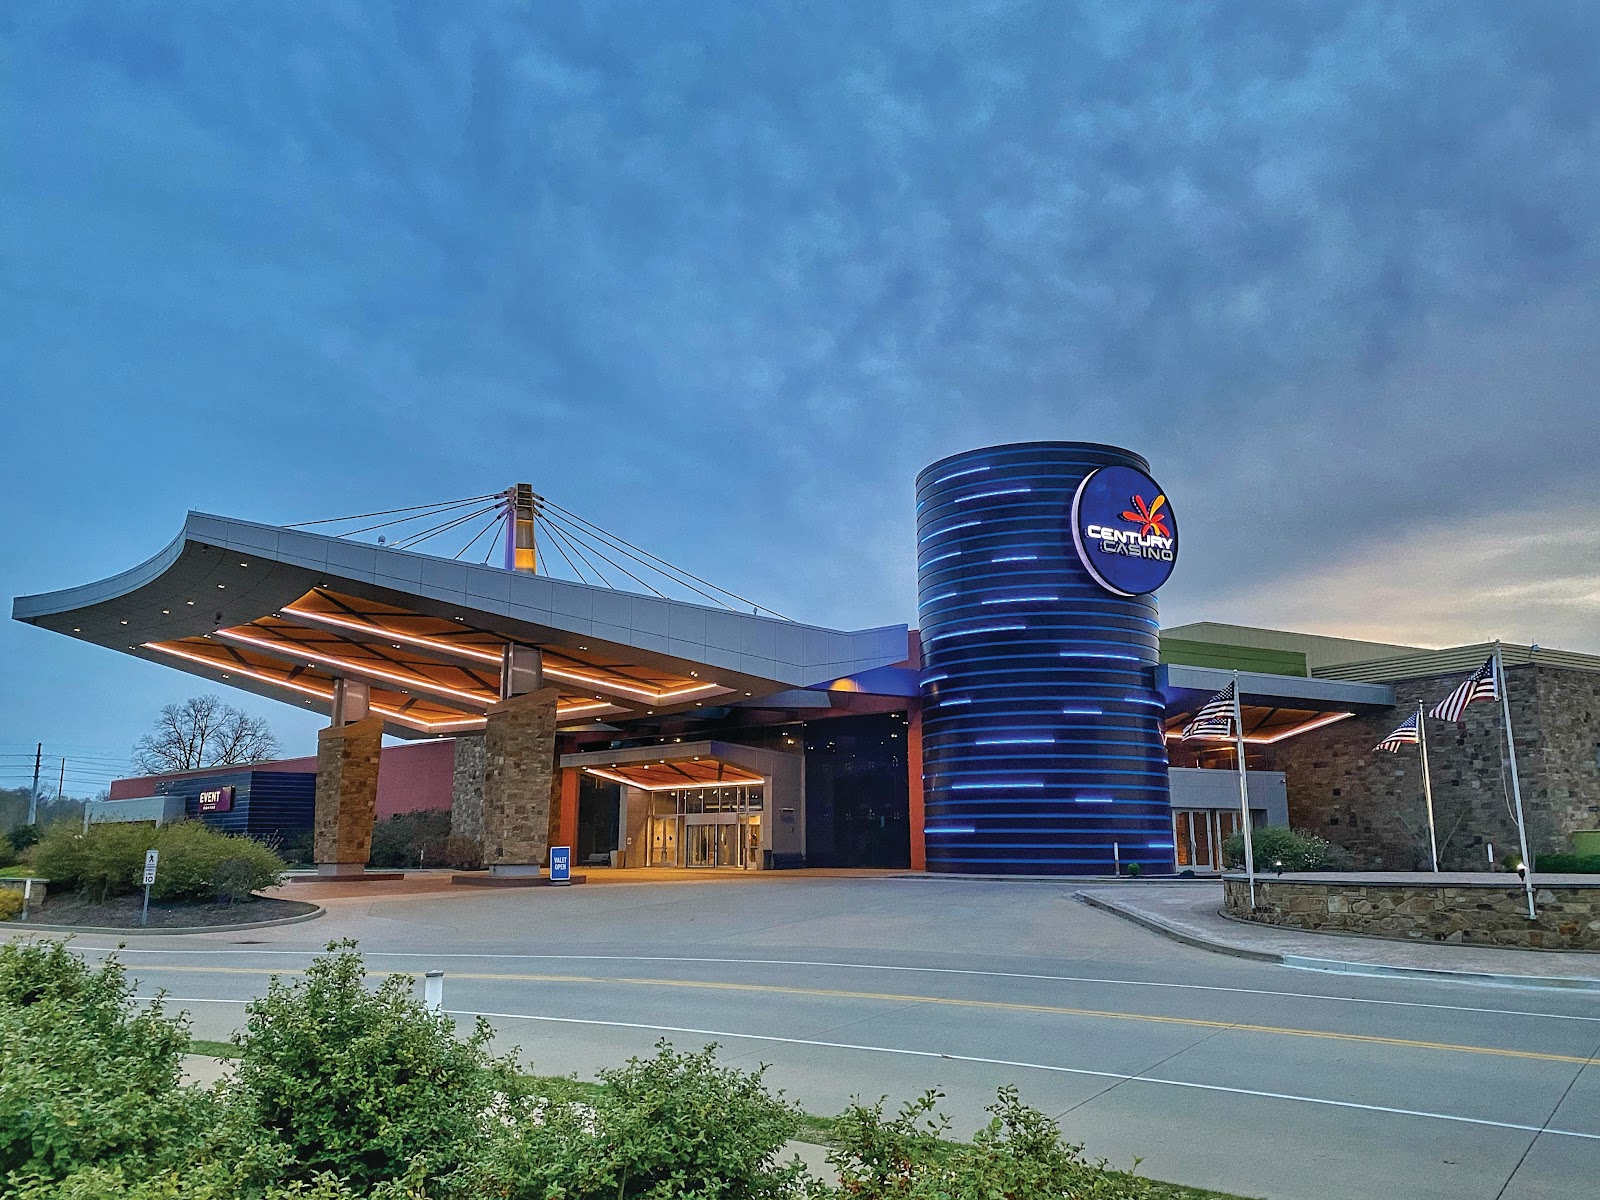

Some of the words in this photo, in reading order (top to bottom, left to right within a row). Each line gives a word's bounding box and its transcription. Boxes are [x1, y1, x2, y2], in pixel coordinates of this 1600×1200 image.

[1087, 525, 1173, 549] CENTURY
[1102, 540, 1174, 561] CASINO
[199, 791, 221, 803] EVENT
